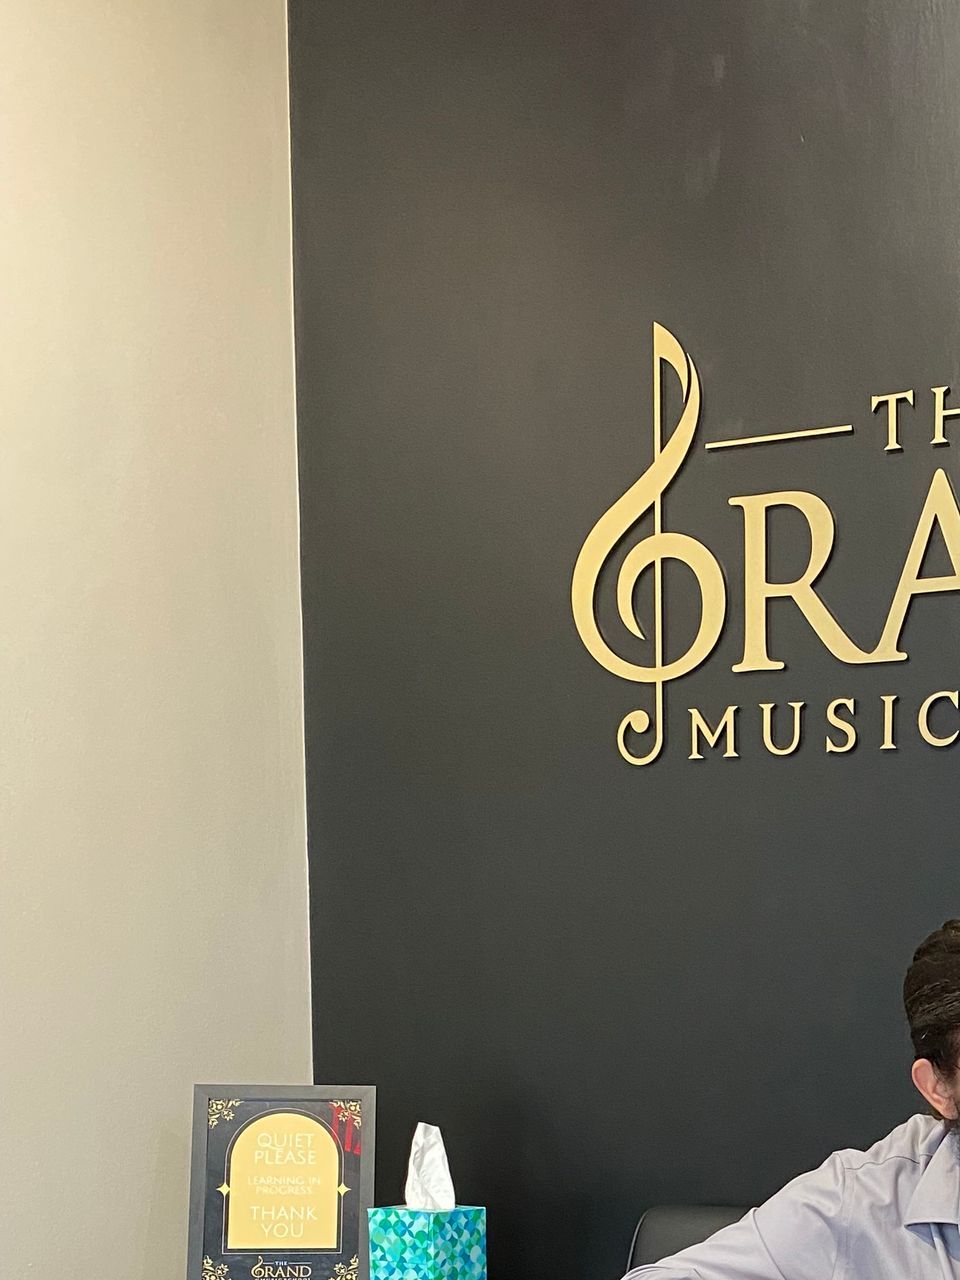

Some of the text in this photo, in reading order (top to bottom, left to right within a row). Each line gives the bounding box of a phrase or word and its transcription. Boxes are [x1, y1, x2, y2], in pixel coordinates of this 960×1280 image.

[686, 690, 960, 761] MUSIC
[257, 1132, 315, 1150] QUIET
[254, 1150, 317, 1165] PLEASE
[248, 1175, 321, 1186] LEARNING IN
[256, 1185, 313, 1196] PROGRESS
[250, 1205, 318, 1221] THANK
[261, 1222, 305, 1238] YOU
